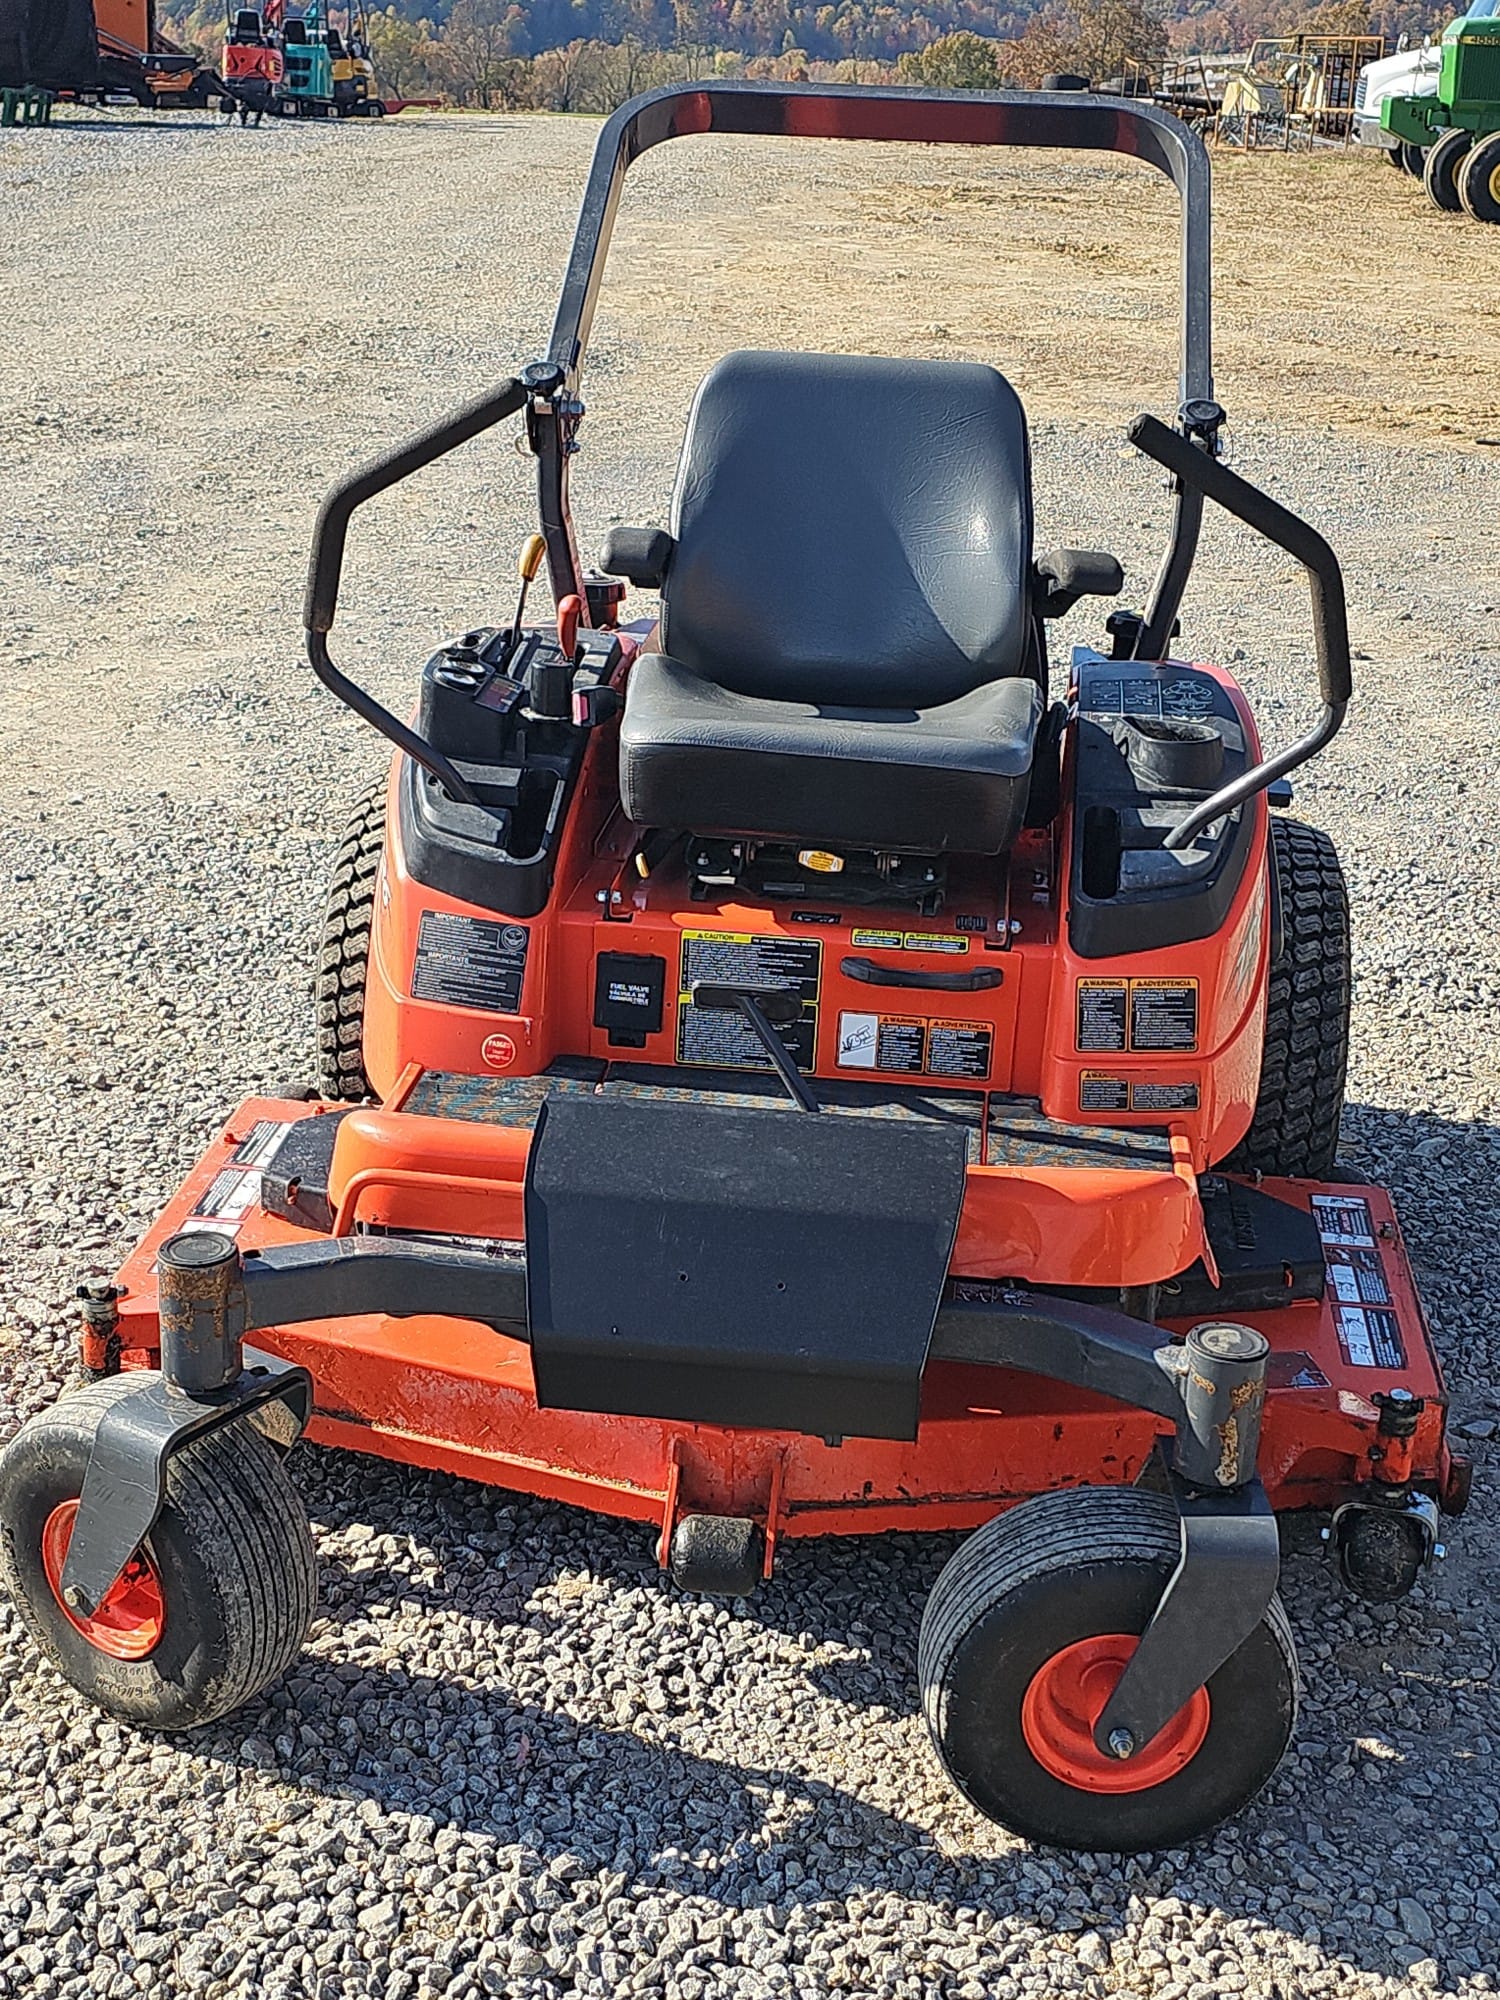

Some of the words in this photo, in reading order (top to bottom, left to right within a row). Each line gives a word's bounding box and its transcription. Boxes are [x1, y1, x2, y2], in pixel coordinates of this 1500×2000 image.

[434, 912, 472, 924] IMPORTANT
[704, 931, 735, 941] CAUTION
[427, 951, 470, 966] IMPORTANTE
[609, 982, 628, 991] FUEL
[627, 984, 651, 994] VALVE
[1090, 979, 1124, 987] WARNING
[1143, 979, 1192, 987] ADVERTENCIA
[889, 1016, 923, 1026] WARNING
[940, 1020, 989, 1031] ADVERTENCIA
